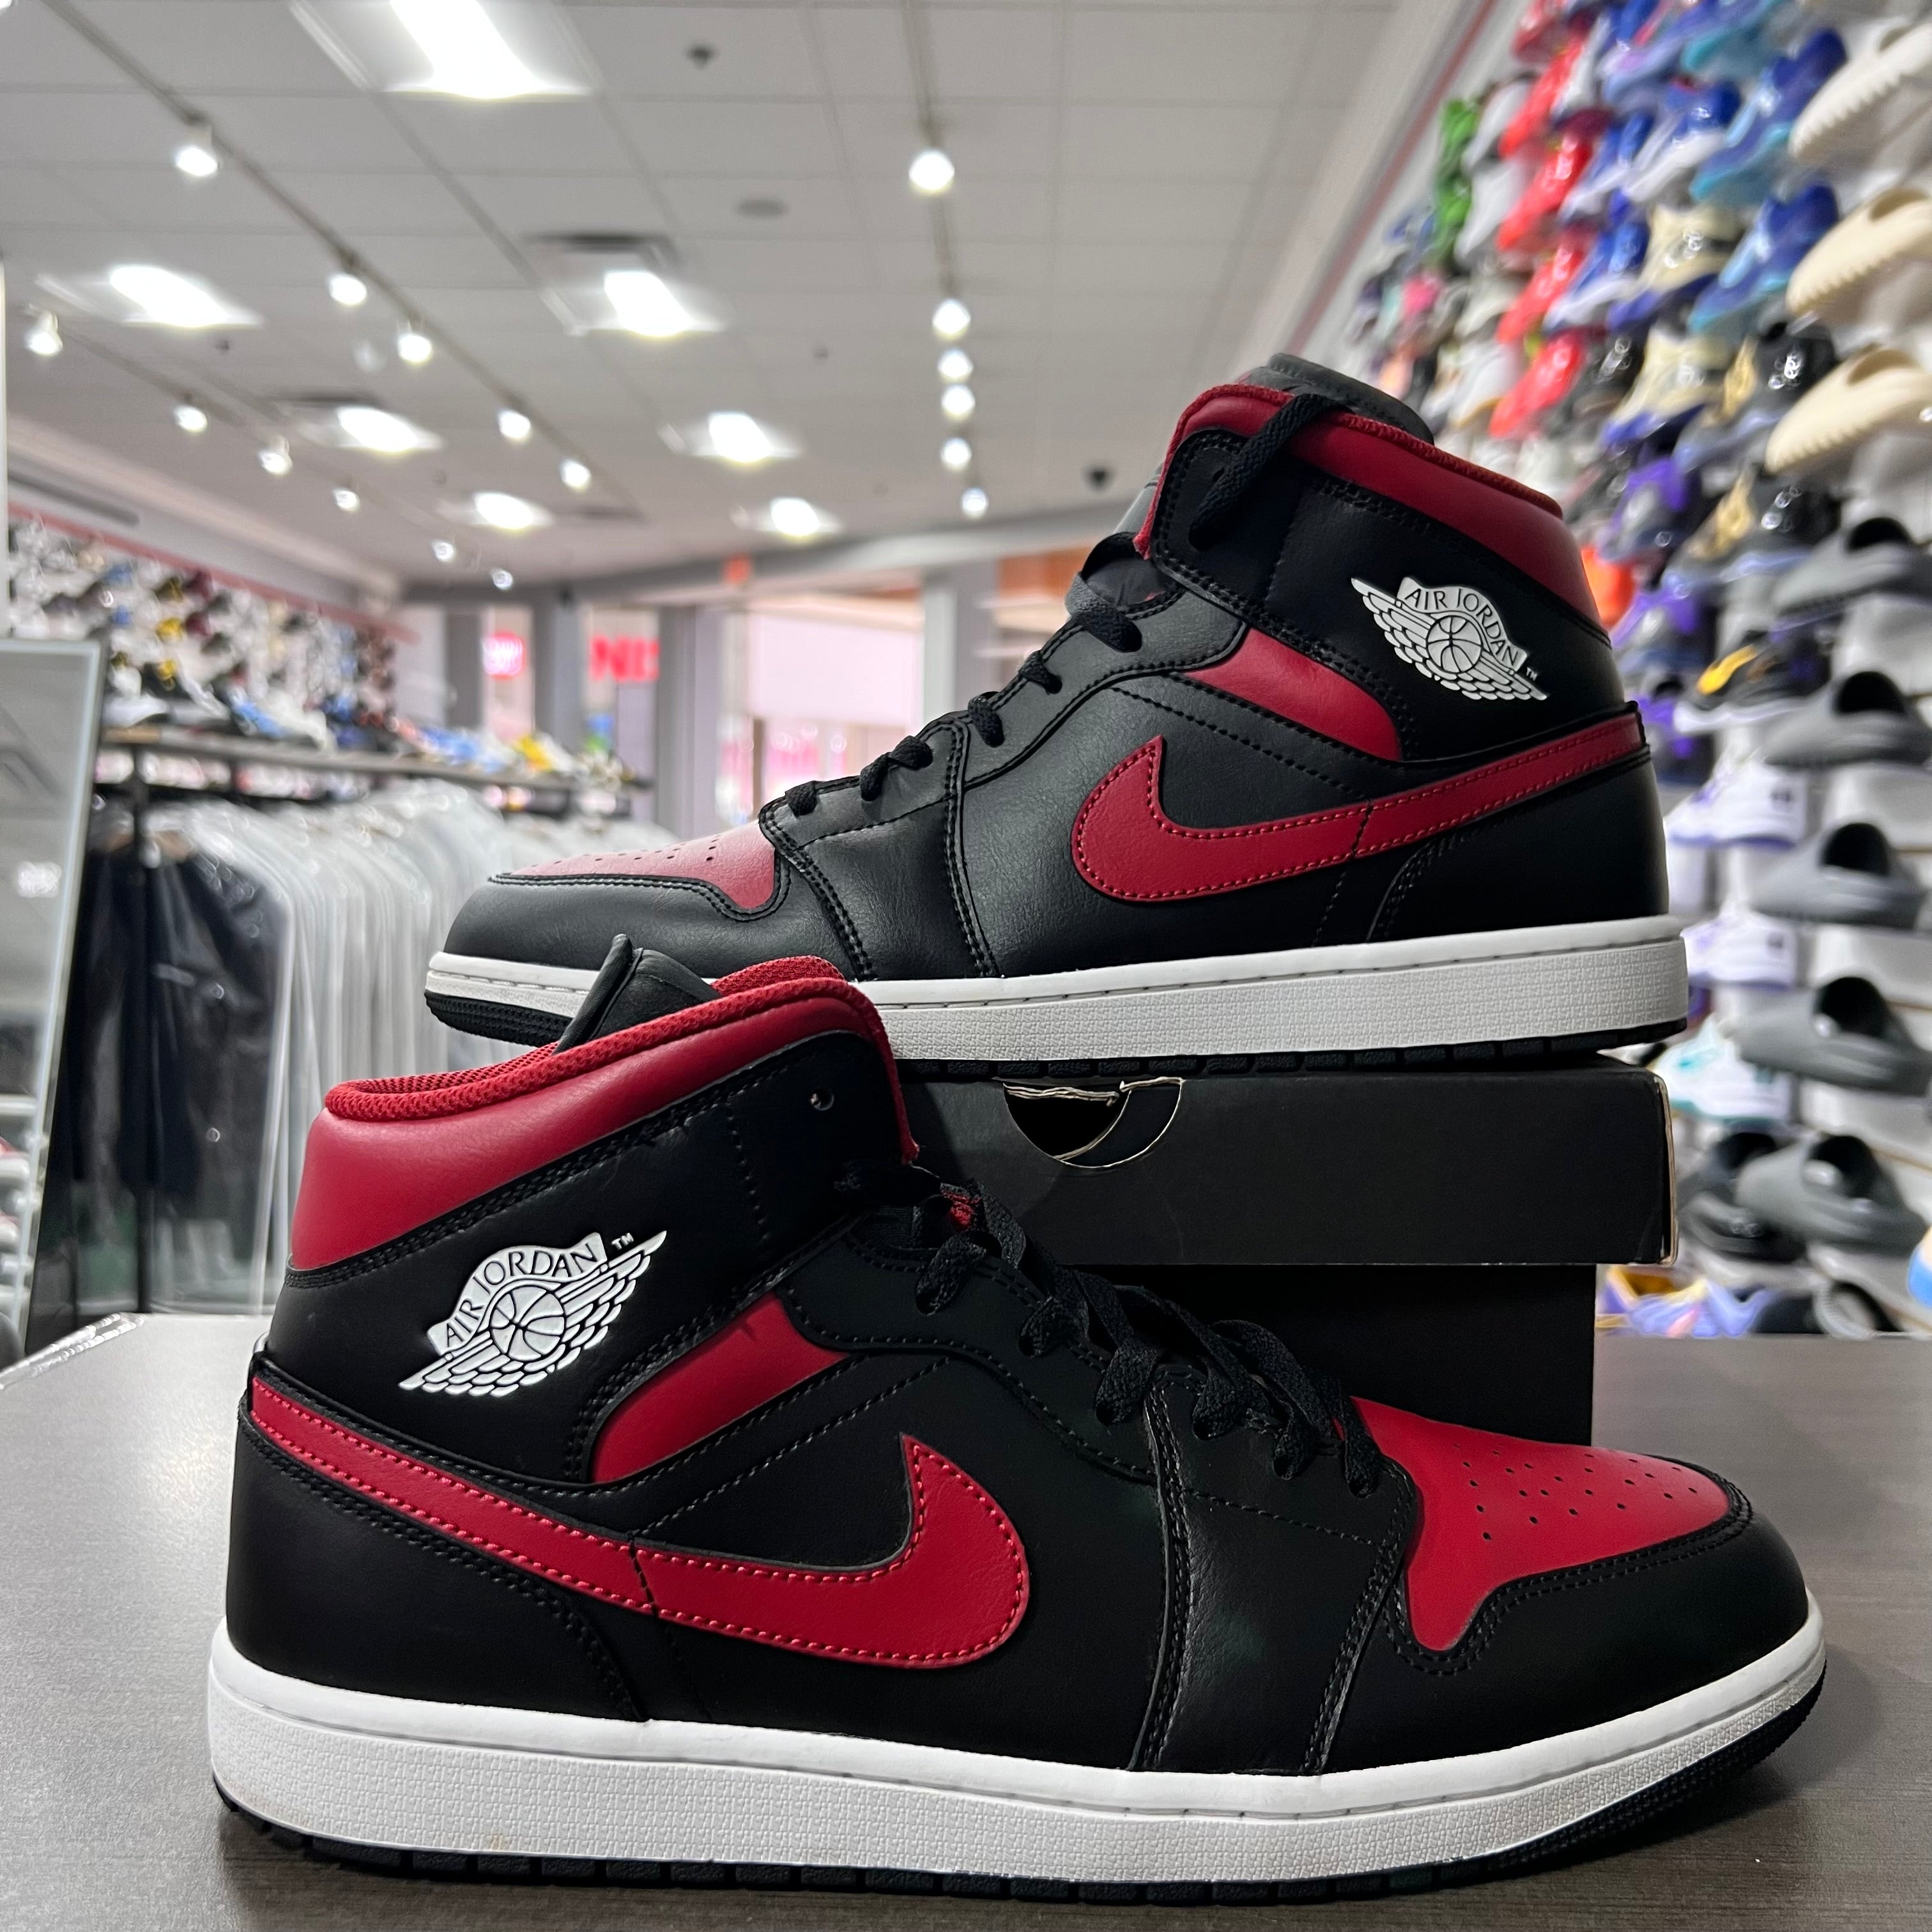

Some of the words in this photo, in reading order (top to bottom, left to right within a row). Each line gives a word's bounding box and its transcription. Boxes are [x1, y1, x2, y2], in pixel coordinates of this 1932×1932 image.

[1404, 588, 1448, 610] AIR
[1457, 588, 1519, 666] JORDAN
[446, 1298, 484, 1347] AIR
[473, 1243, 598, 1295] JORDAN
